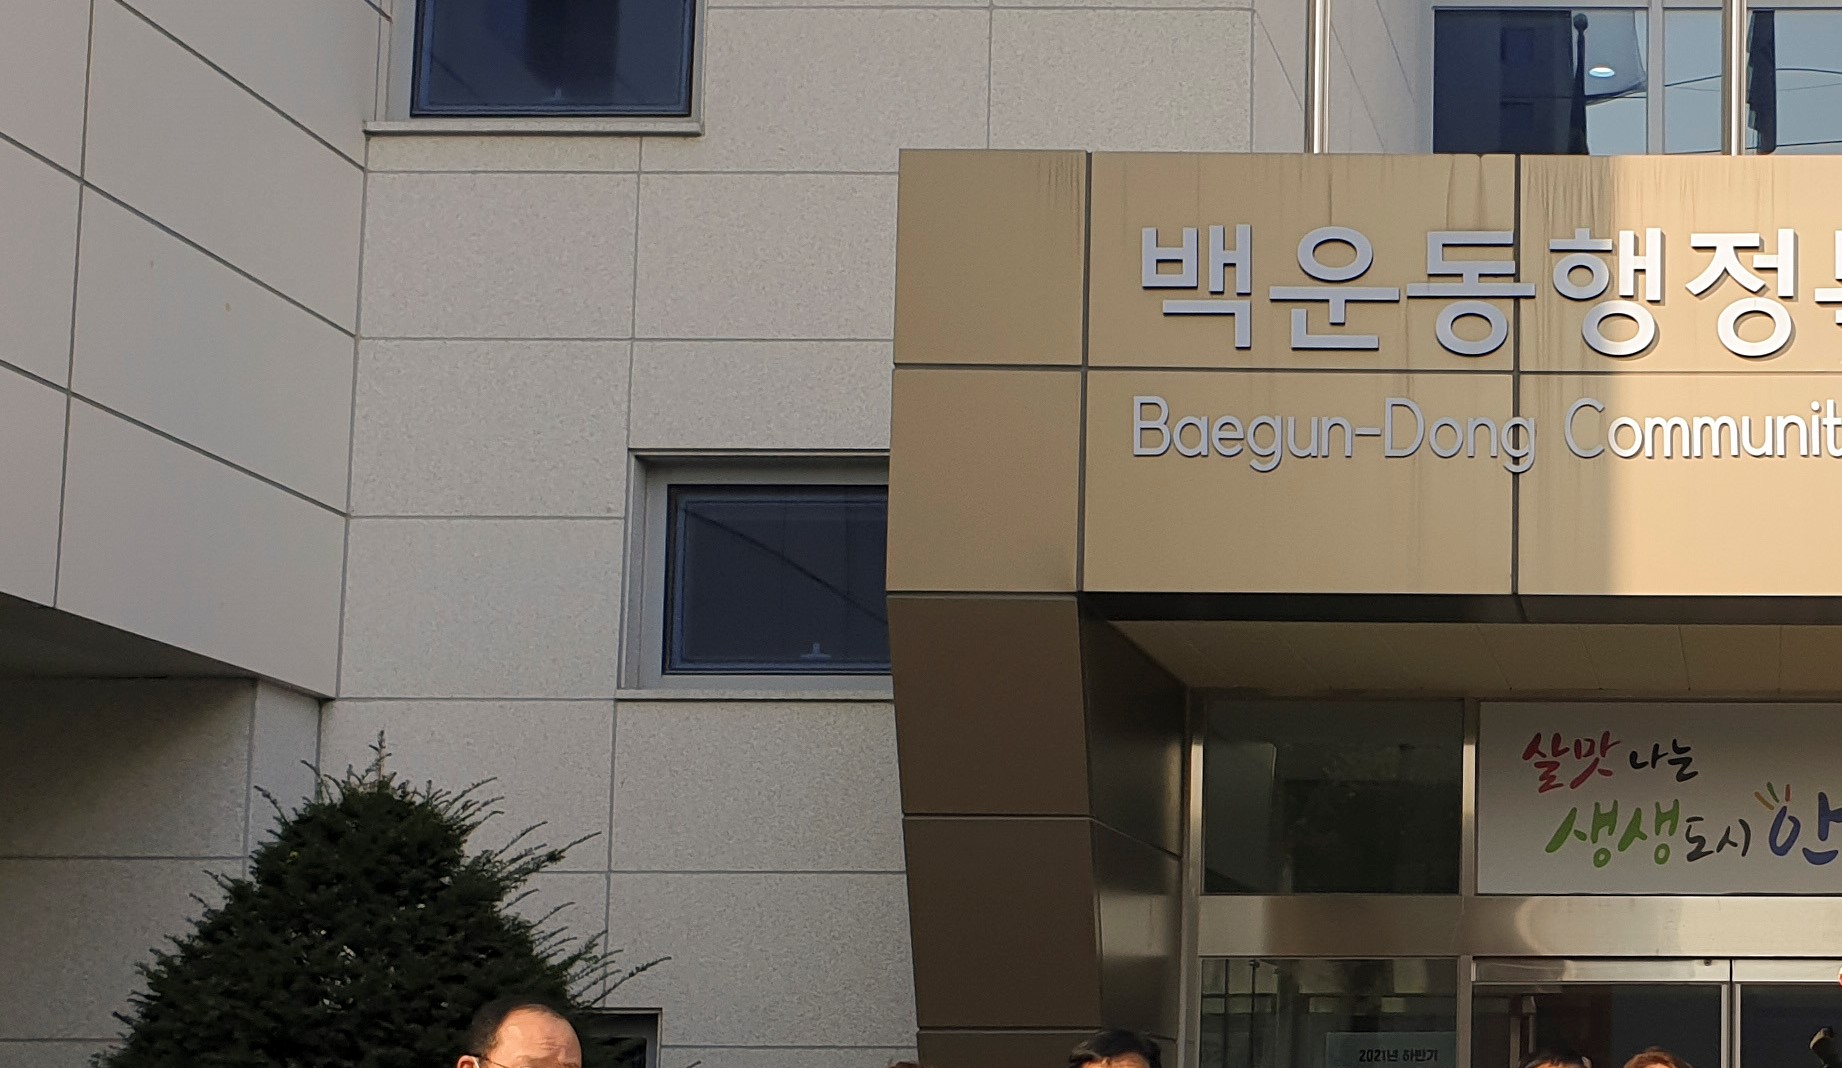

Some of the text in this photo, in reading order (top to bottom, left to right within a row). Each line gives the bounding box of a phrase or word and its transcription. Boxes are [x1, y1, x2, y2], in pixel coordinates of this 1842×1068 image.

[1132, 395, 1537, 474] Baegun-Dong
[1521, 730, 1698, 794] 살맛 나는
[1545, 799, 1751, 867] 생생도시
[1359, 1049, 1438, 1062] 2021년 하반기
